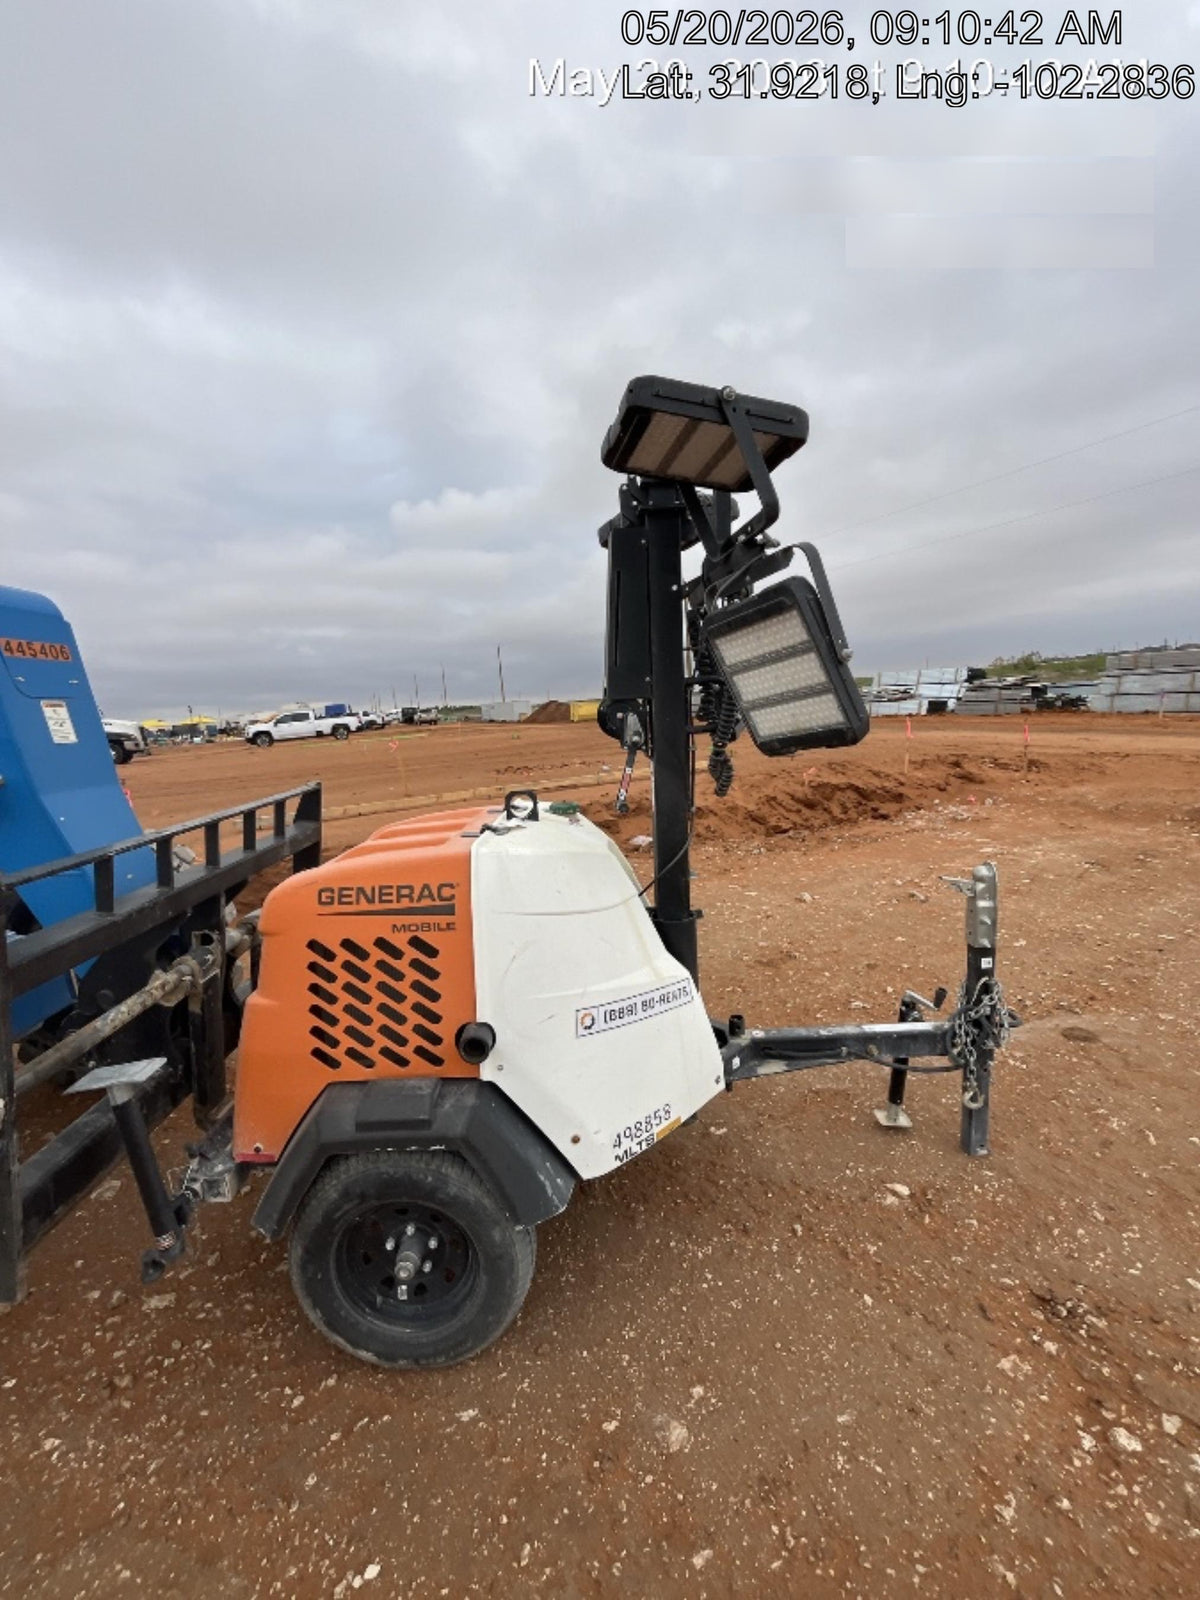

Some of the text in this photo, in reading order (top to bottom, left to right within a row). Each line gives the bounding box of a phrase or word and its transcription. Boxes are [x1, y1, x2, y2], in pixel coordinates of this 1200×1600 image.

[4, 639, 70, 661] 445406
[317, 882, 457, 906] GENERAC
[391, 921, 456, 934] MOBILE
[612, 1103, 671, 1150] 498858
